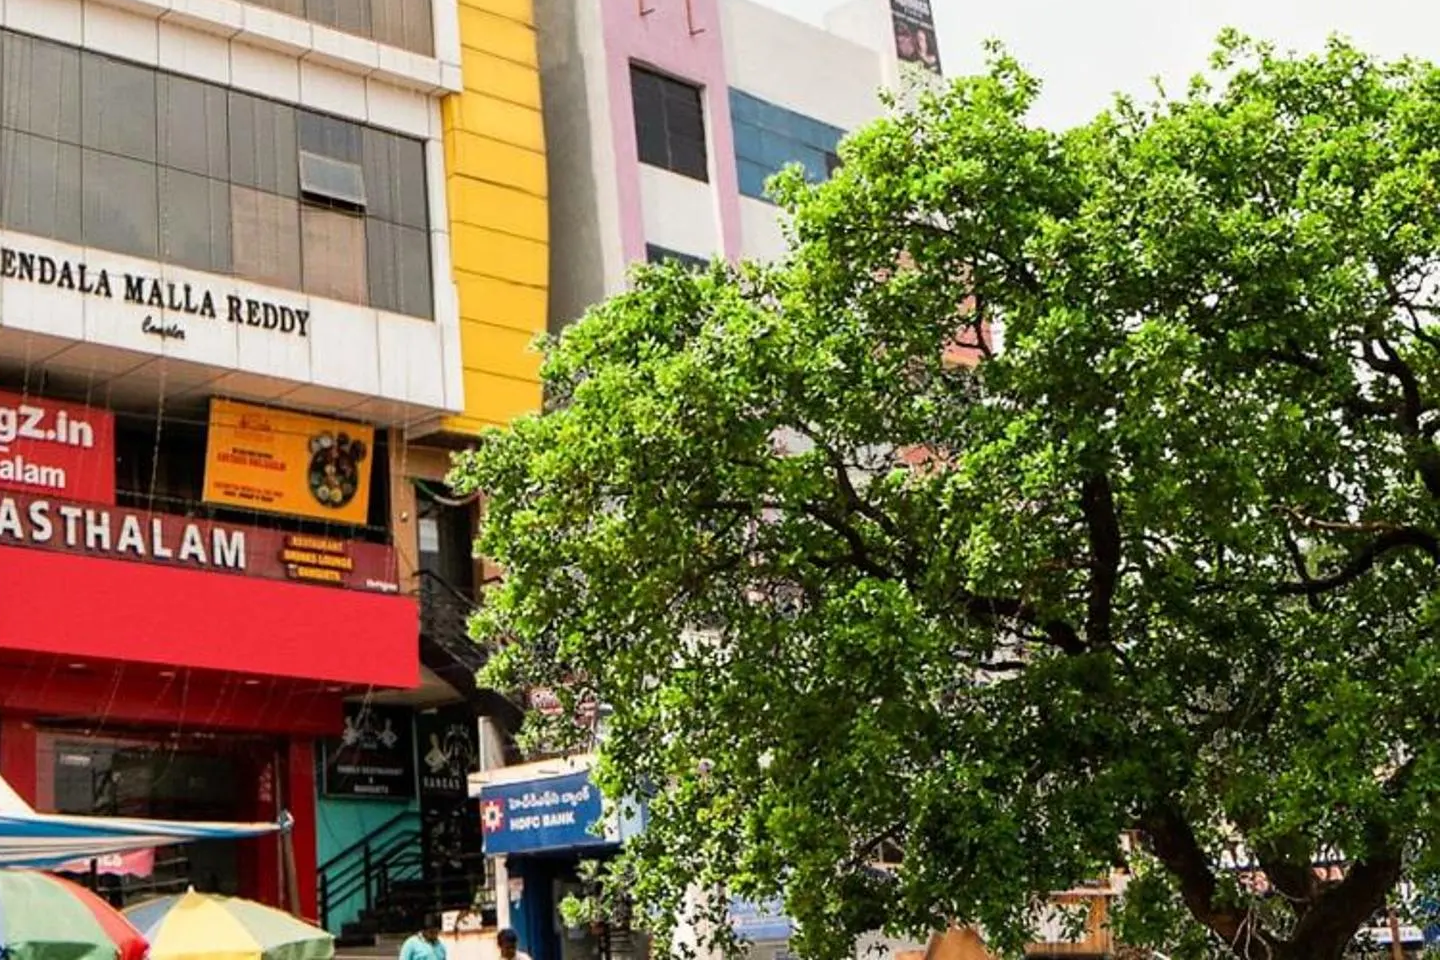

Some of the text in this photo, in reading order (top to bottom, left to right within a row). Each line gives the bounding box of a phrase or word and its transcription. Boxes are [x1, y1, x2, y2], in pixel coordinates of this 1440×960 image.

[0, 247, 310, 338] ENDALA MALLA REDDY
[510, 810, 576, 831] HDFC BANK
